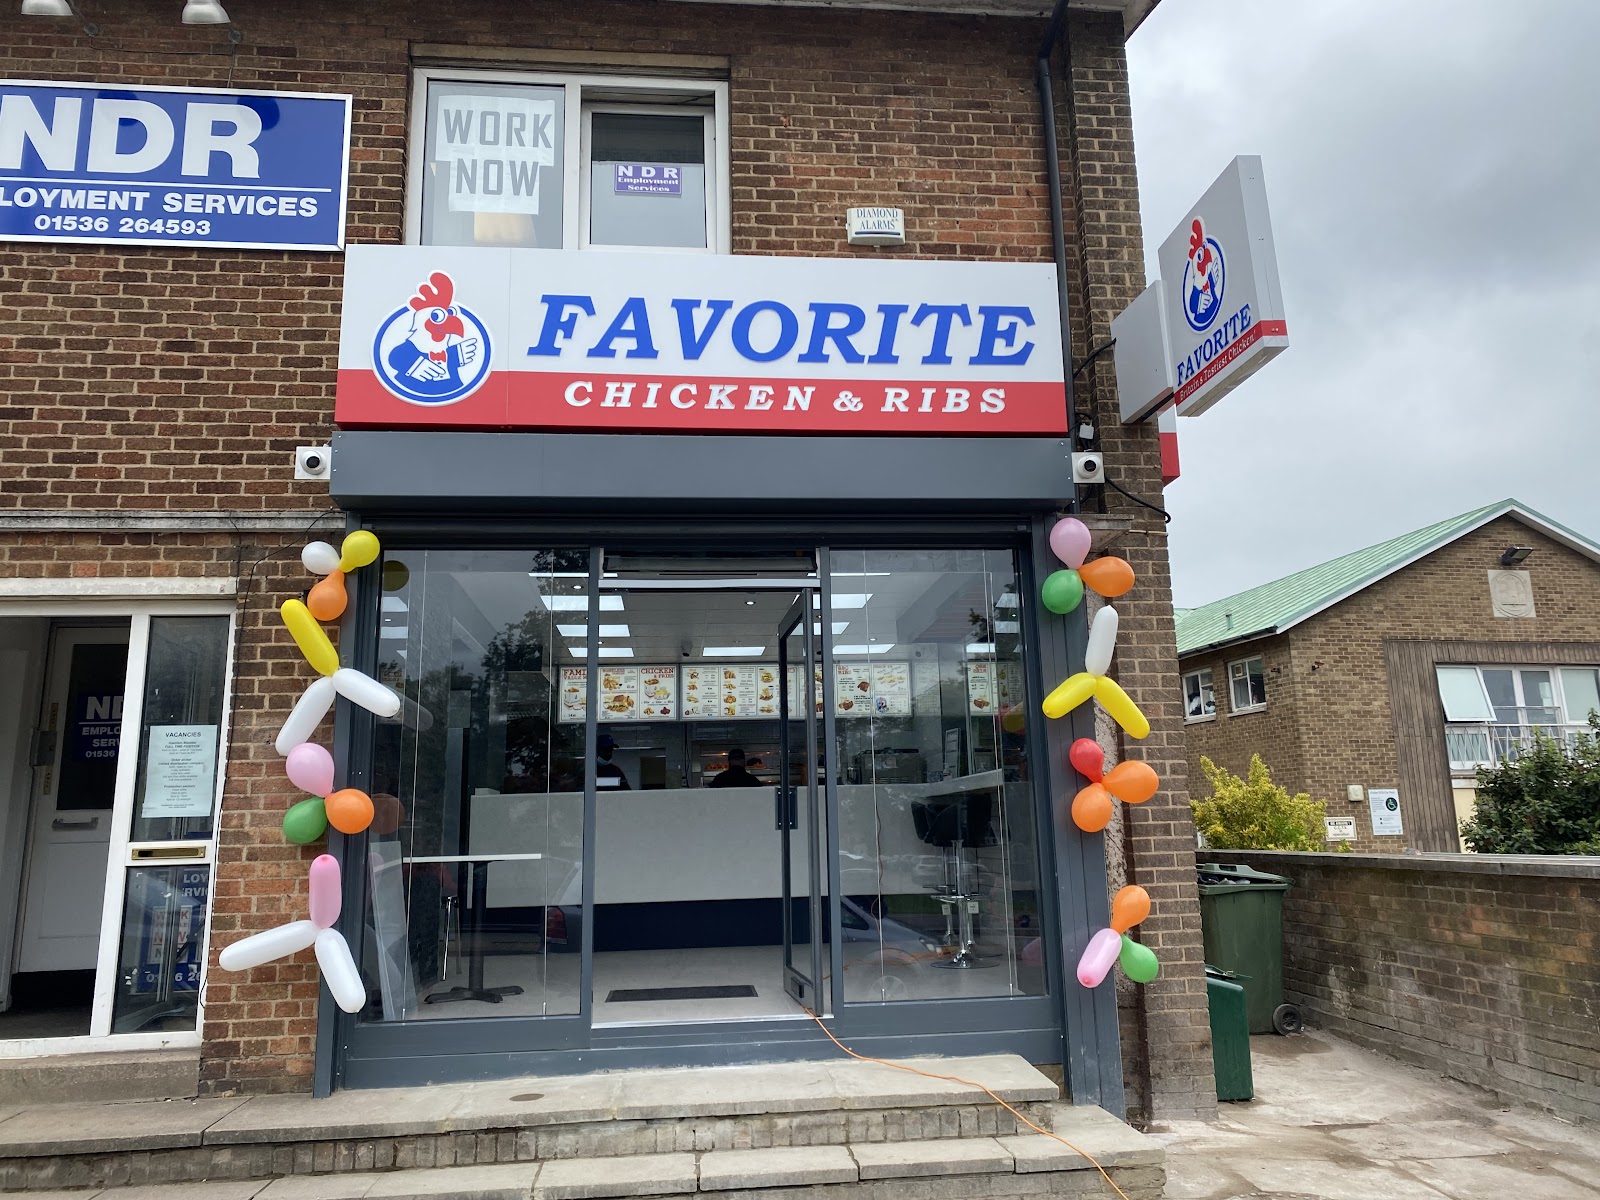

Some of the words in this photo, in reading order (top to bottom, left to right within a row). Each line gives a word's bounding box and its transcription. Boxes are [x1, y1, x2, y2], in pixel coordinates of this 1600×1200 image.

[0, 94, 262, 178] NDR
[443, 108, 552, 148] WORK
[455, 157, 540, 197] NOW
[617, 176, 679, 185] Employment
[627, 184, 670, 192] Services
[163, 192, 318, 217] SERVICES
[856, 208, 898, 218] DIAMOND
[34, 214, 109, 232] 01536
[118, 217, 211, 235] 264593
[860, 220, 896, 230] ALARMS
[527, 293, 1036, 366] FAVORITE
[1176, 303, 1252, 388] FAVORITE
[564, 380, 816, 412] CHICKEN
[833, 387, 865, 412] &
[880, 386, 1007, 413] RIBS
[85, 750, 115, 758] 01536
